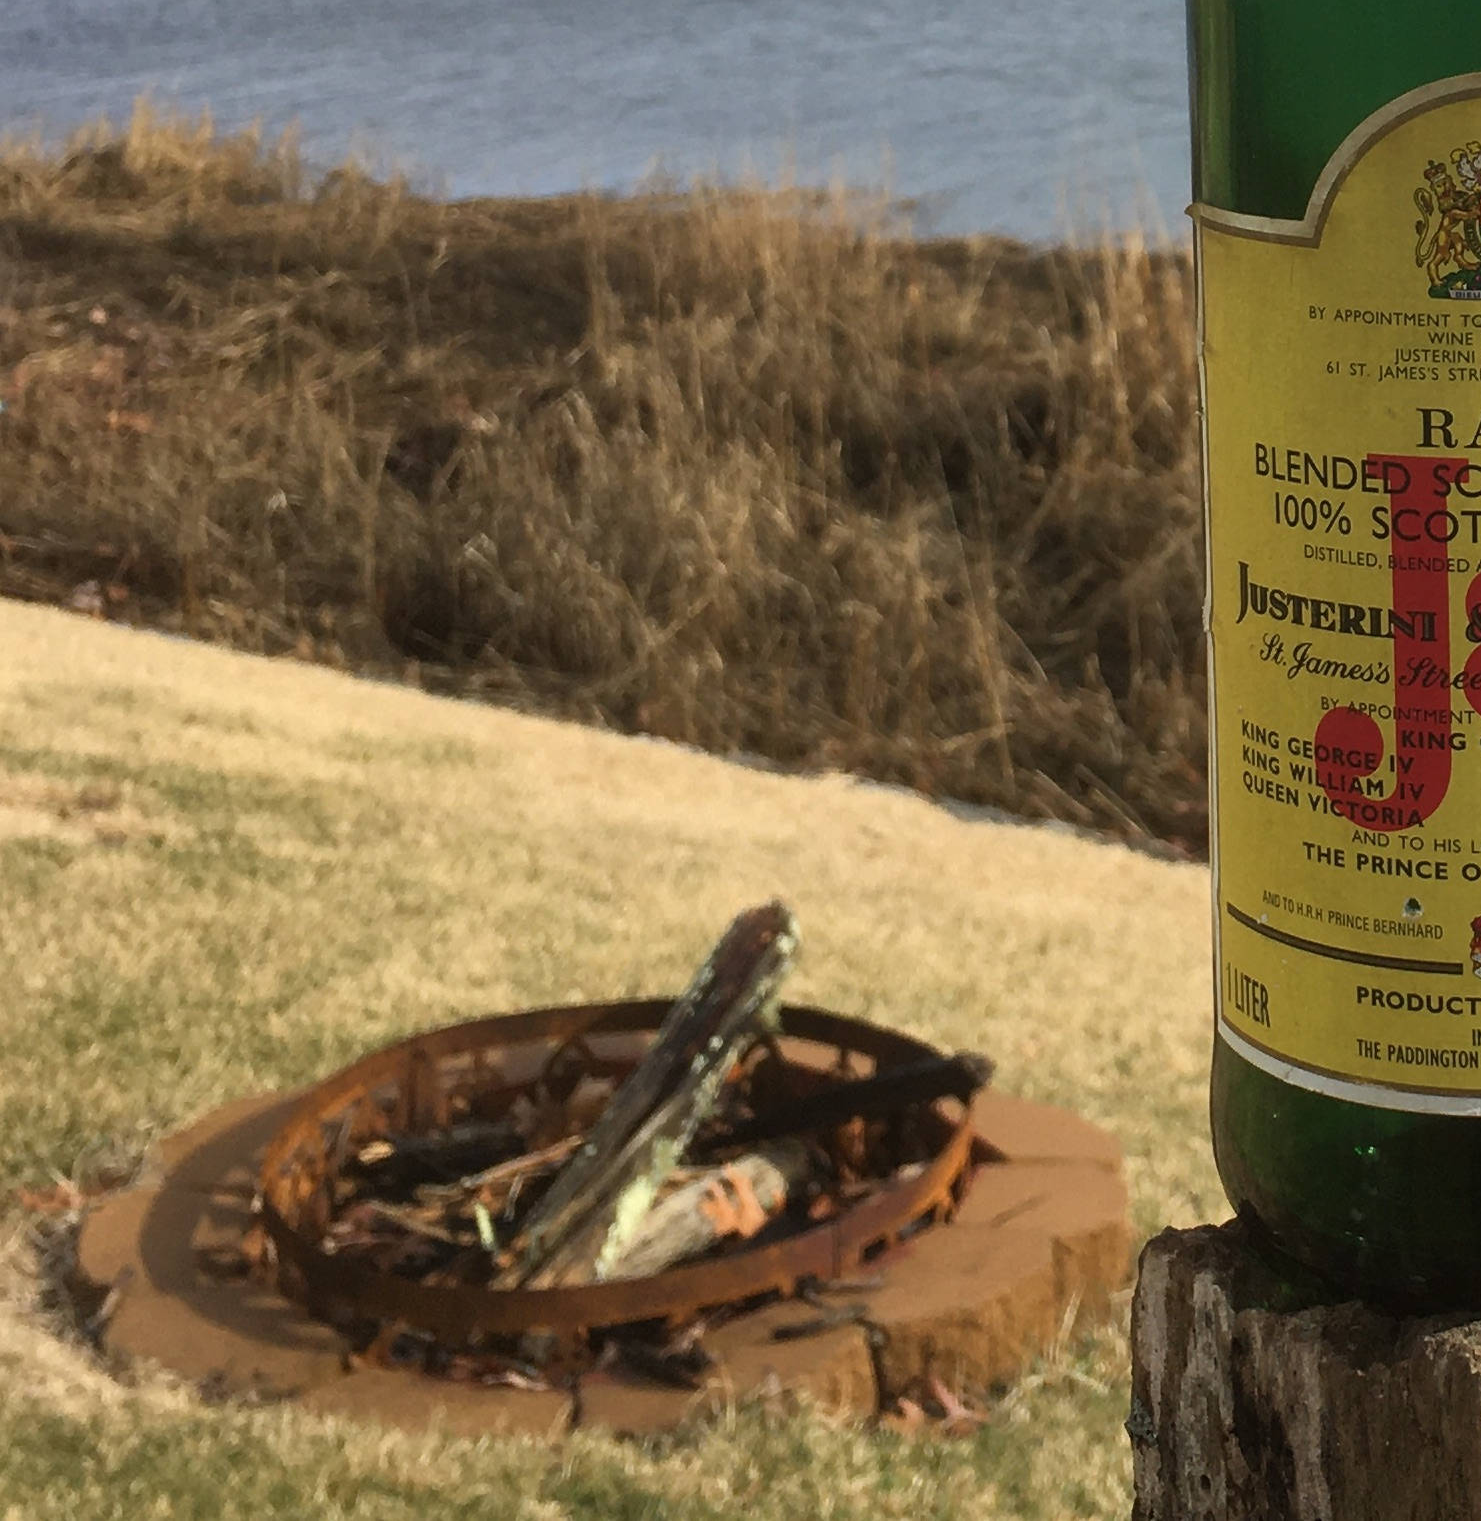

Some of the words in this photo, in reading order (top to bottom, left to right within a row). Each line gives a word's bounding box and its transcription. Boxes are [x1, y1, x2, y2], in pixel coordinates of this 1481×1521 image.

[1309, 305, 1326, 320] BY
[1334, 308, 1450, 328] APPOINTMENT
[1428, 331, 1473, 346] WINE
[1326, 361, 1340, 375] 61
[1350, 363, 1370, 377] ST.
[1378, 365, 1440, 382] JAMES'S
[1394, 348, 1475, 365] JUSTERINI
[1255, 442, 1412, 496] BLENDED
[1275, 492, 1352, 535] 100%
[1303, 544, 1382, 570] DISTILLED,
[1388, 554, 1470, 574] BLENDED
[1236, 561, 1438, 643] JUSTERINI
[1320, 696, 1339, 711] BY
[1347, 701, 1476, 725] APPOINTMENT
[1241, 719, 1280, 749] KING
[1287, 736, 1377, 771] GEORGE
[1389, 754, 1415, 774] IV
[1402, 729, 1467, 751] KING
[1242, 744, 1280, 775] KING
[1289, 762, 1384, 798] WILLIAM
[1399, 783, 1425, 801] IV
[1242, 771, 1299, 807] QUEEN
[1308, 793, 1425, 829] VICTORIA
[1351, 829, 1390, 848] AND
[1398, 834, 1425, 852] TO
[1433, 838, 1462, 854] HIS
[1302, 841, 1346, 869] THE
[1356, 852, 1449, 880] PRINCE
[1262, 890, 1281, 908] AND
[1283, 896, 1295, 914] TO
[1328, 910, 1370, 932] PRINCE
[1373, 918, 1444, 940] BERNHARD
[1234, 967, 1271, 1028] LITER
[1356, 985, 1481, 1016] PRODUCT
[1357, 1039, 1382, 1061] THE
[1388, 1044, 1479, 1070] PADDINGTON
